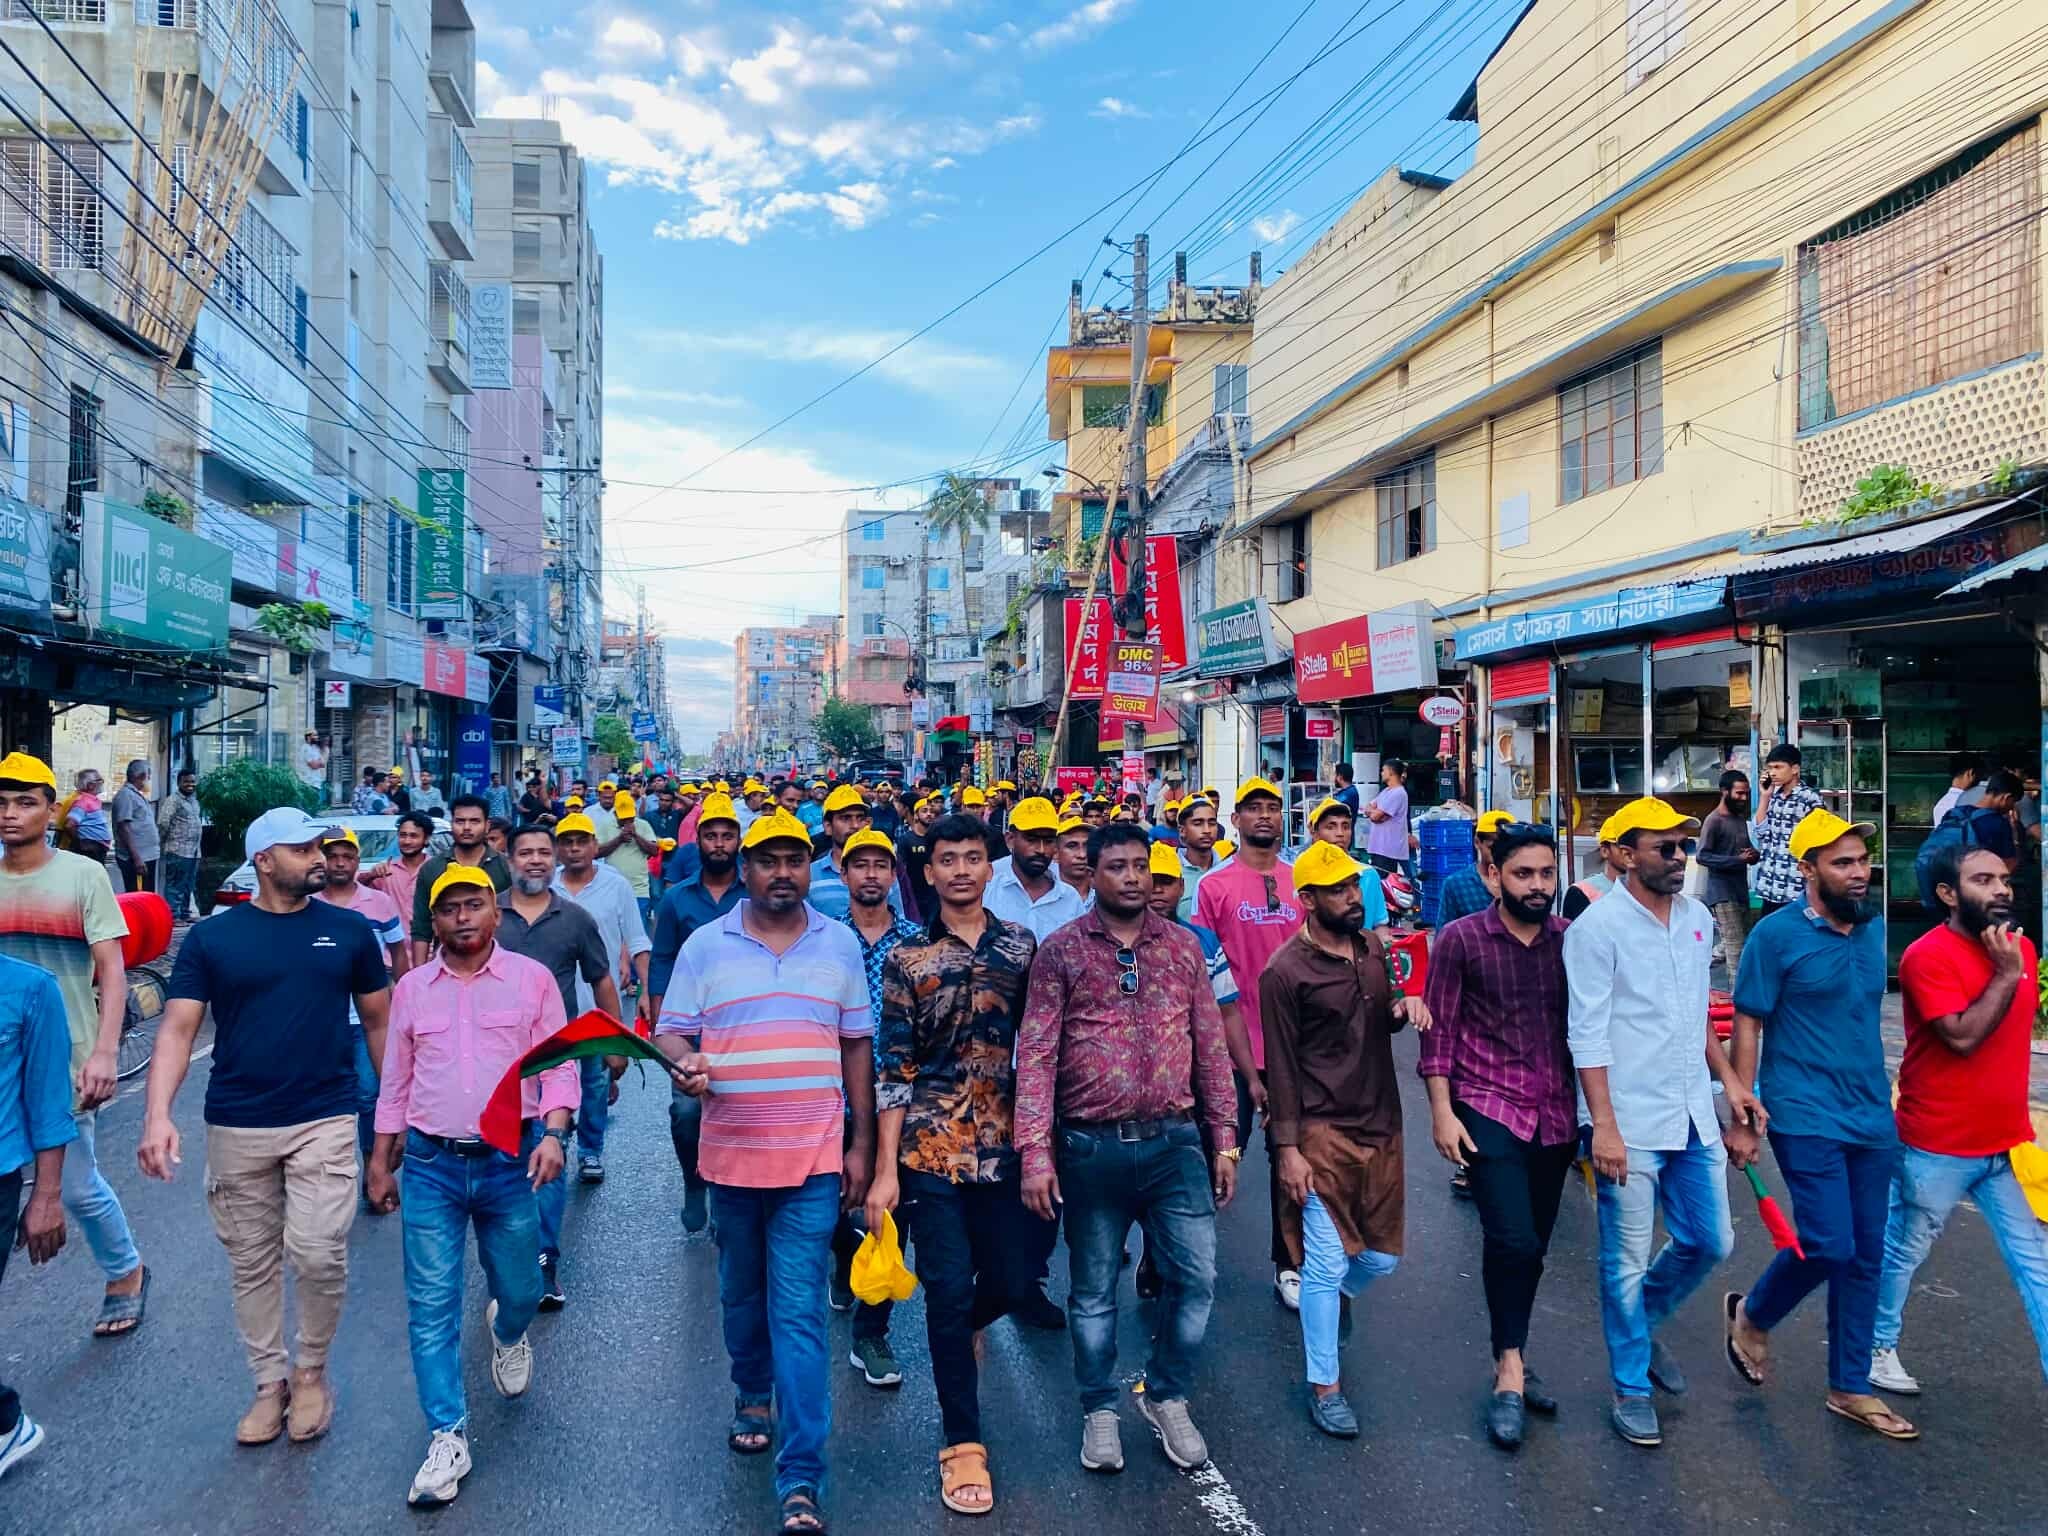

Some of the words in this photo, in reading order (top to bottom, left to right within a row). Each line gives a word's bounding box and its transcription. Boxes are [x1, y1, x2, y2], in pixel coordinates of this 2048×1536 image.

[1468, 625, 1507, 652] মেসার্স
[1513, 612, 1571, 643] আফরা
[1118, 648, 1154, 661] DMC
[1123, 661, 1153, 673] 96%
[1305, 653, 1328, 675] Stella
[1437, 705, 1460, 717] Stella
[462, 729, 485, 743] dbl
